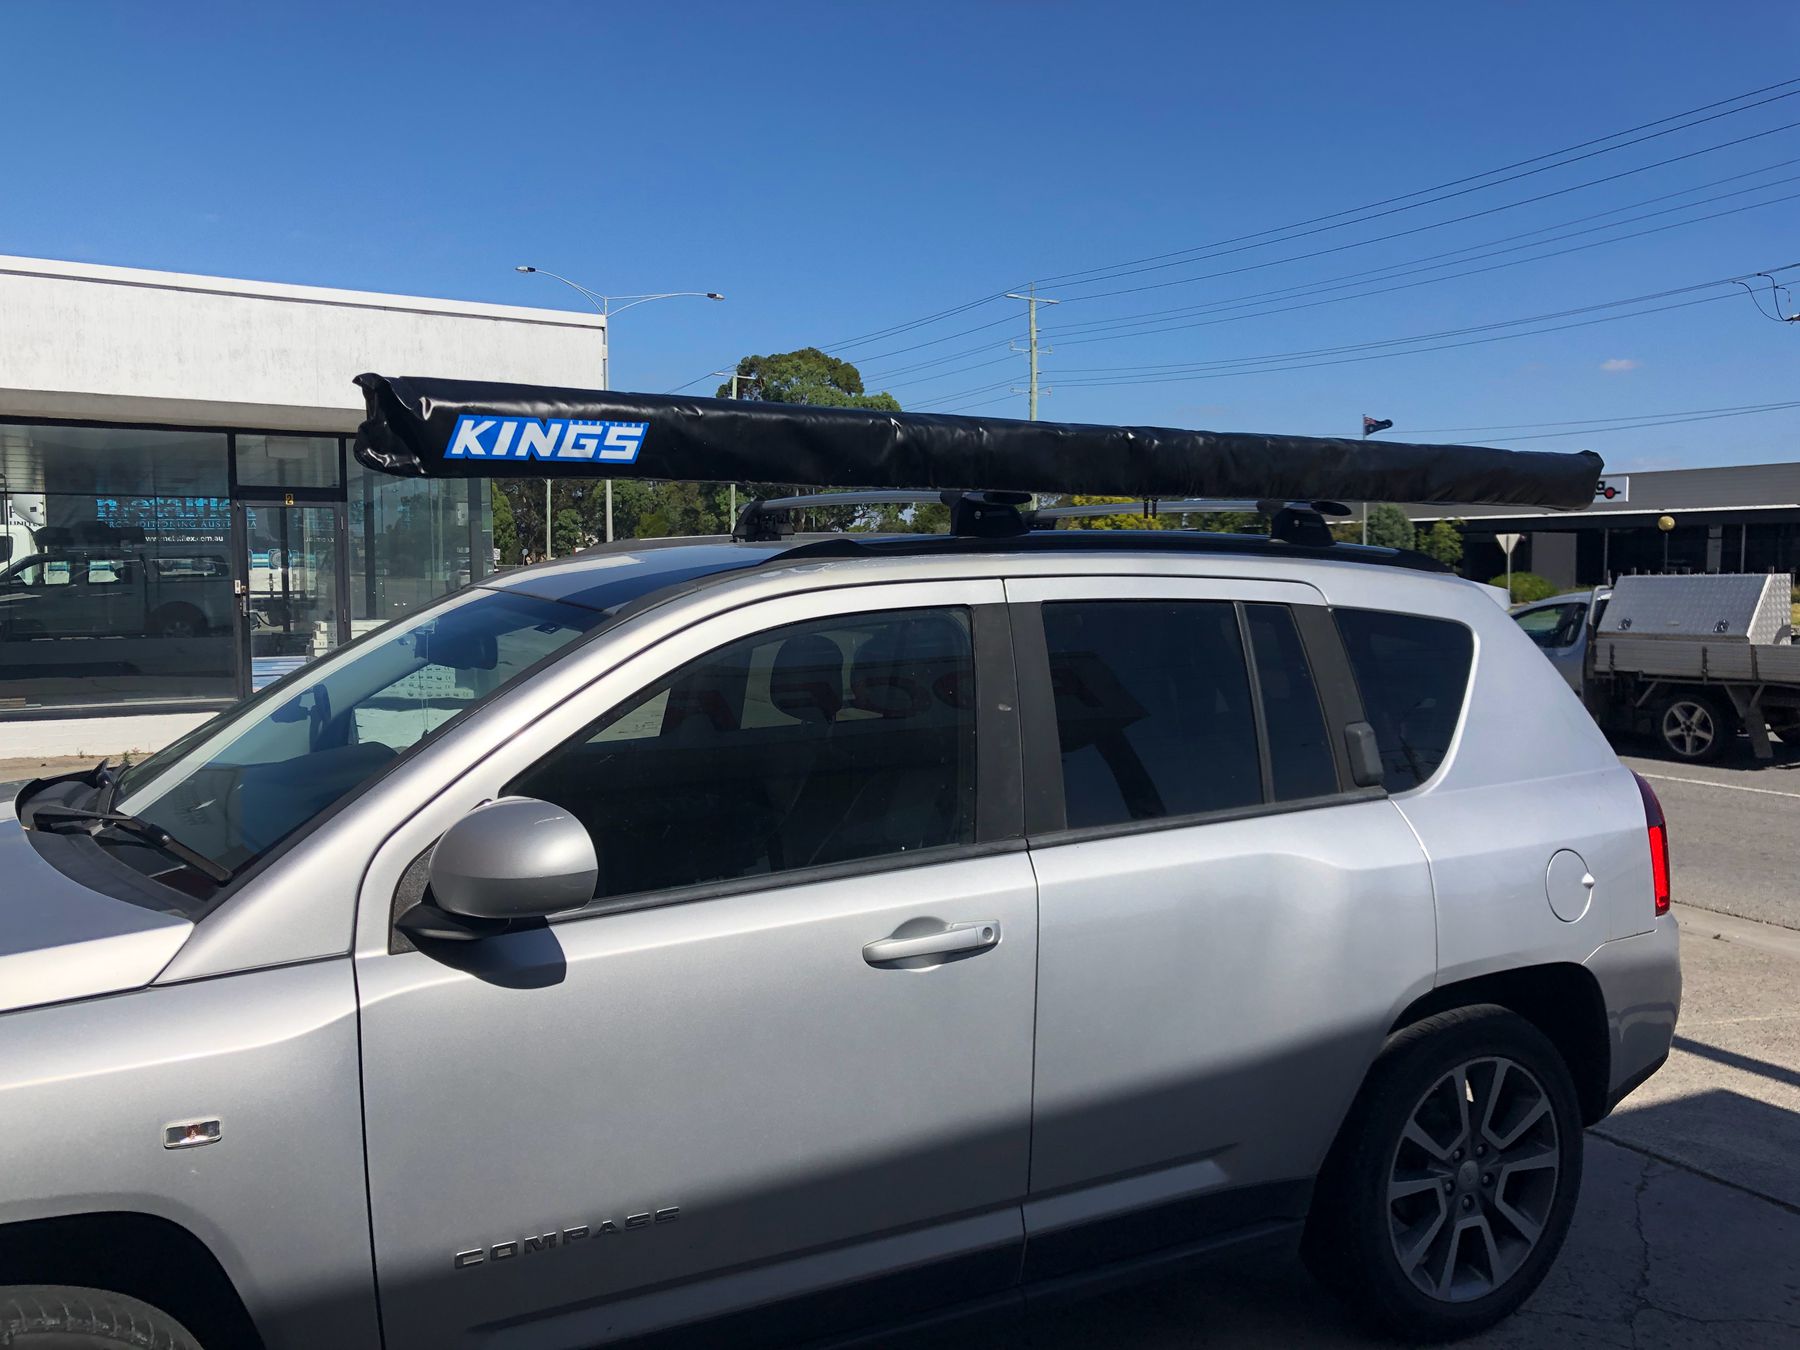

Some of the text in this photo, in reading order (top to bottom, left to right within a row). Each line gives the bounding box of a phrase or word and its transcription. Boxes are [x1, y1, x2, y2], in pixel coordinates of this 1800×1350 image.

[451, 420, 644, 460] KINGS
[569, 419, 645, 428] ADVENTURE
[454, 1206, 681, 1269] COMPASS
